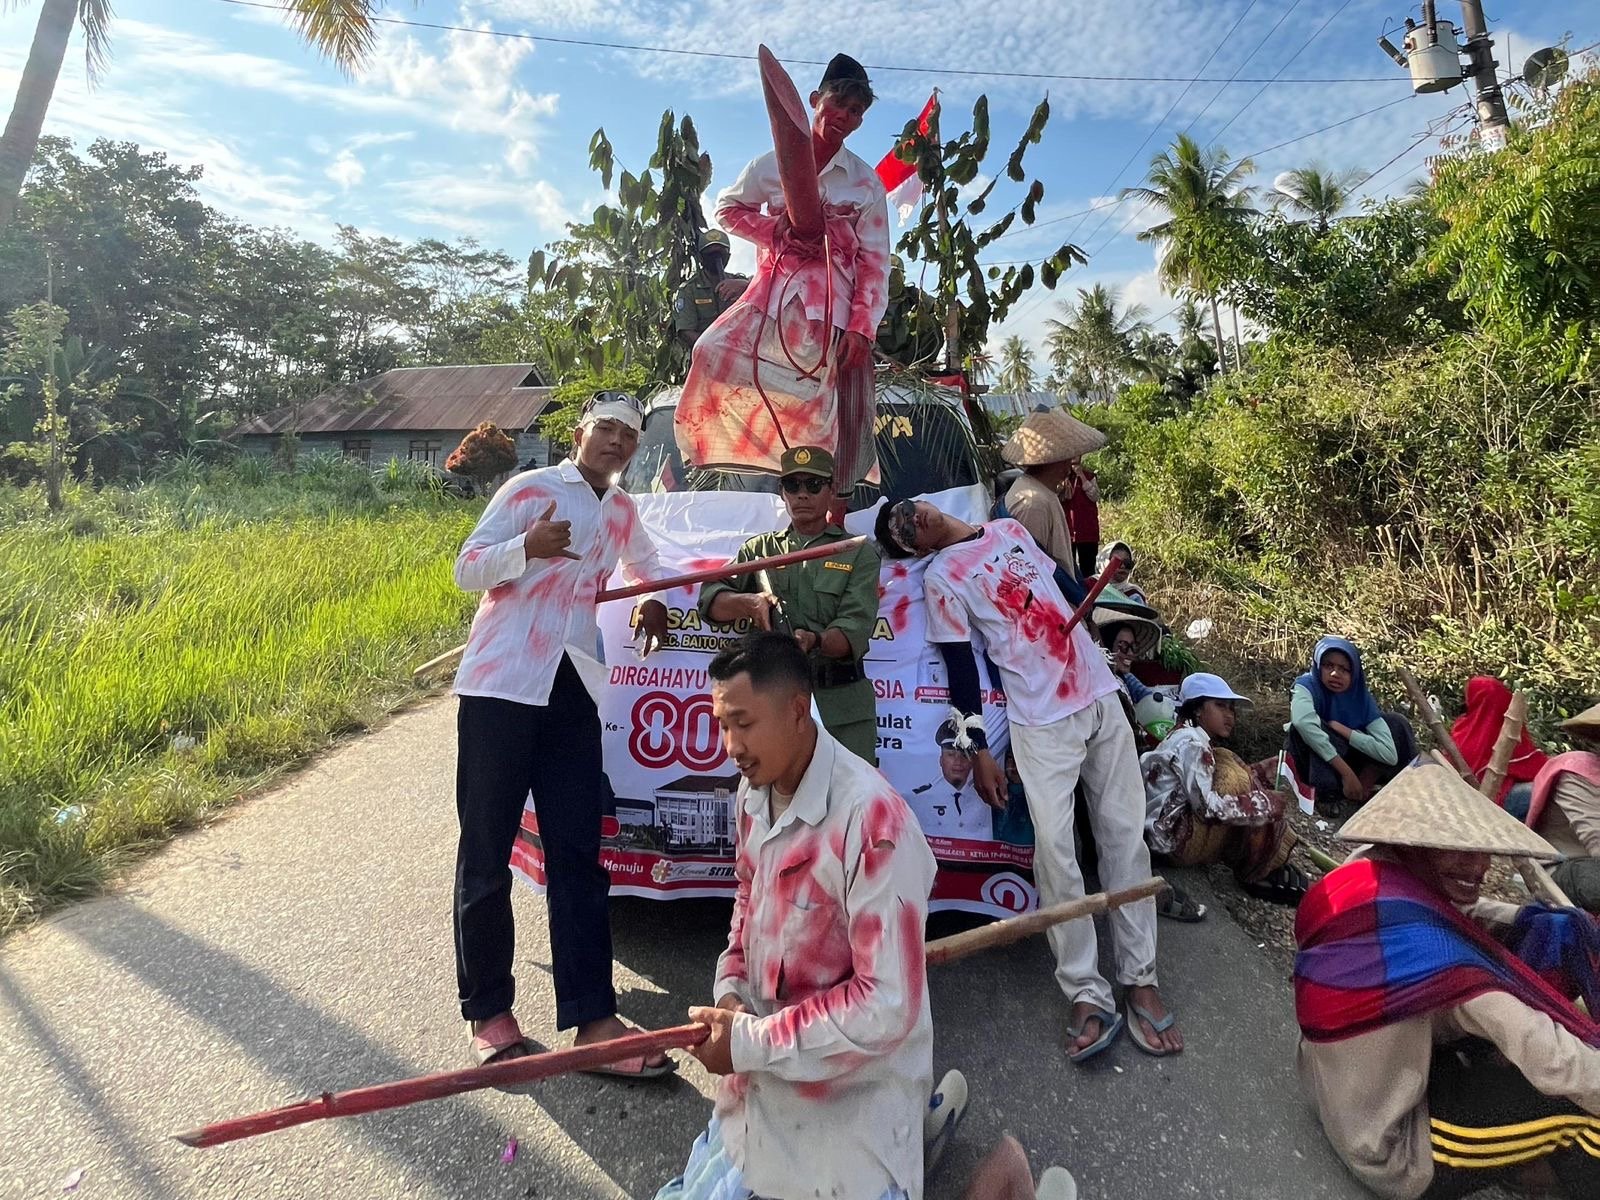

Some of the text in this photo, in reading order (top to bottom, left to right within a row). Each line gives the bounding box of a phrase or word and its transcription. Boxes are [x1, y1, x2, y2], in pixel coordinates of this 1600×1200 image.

[682, 635, 717, 648] BAITO
[610, 666, 706, 689] DIRGAHAYU
[628, 690, 729, 772] 80
[969, 851, 989, 859] KETUA
[604, 859, 643, 873] Menuju
